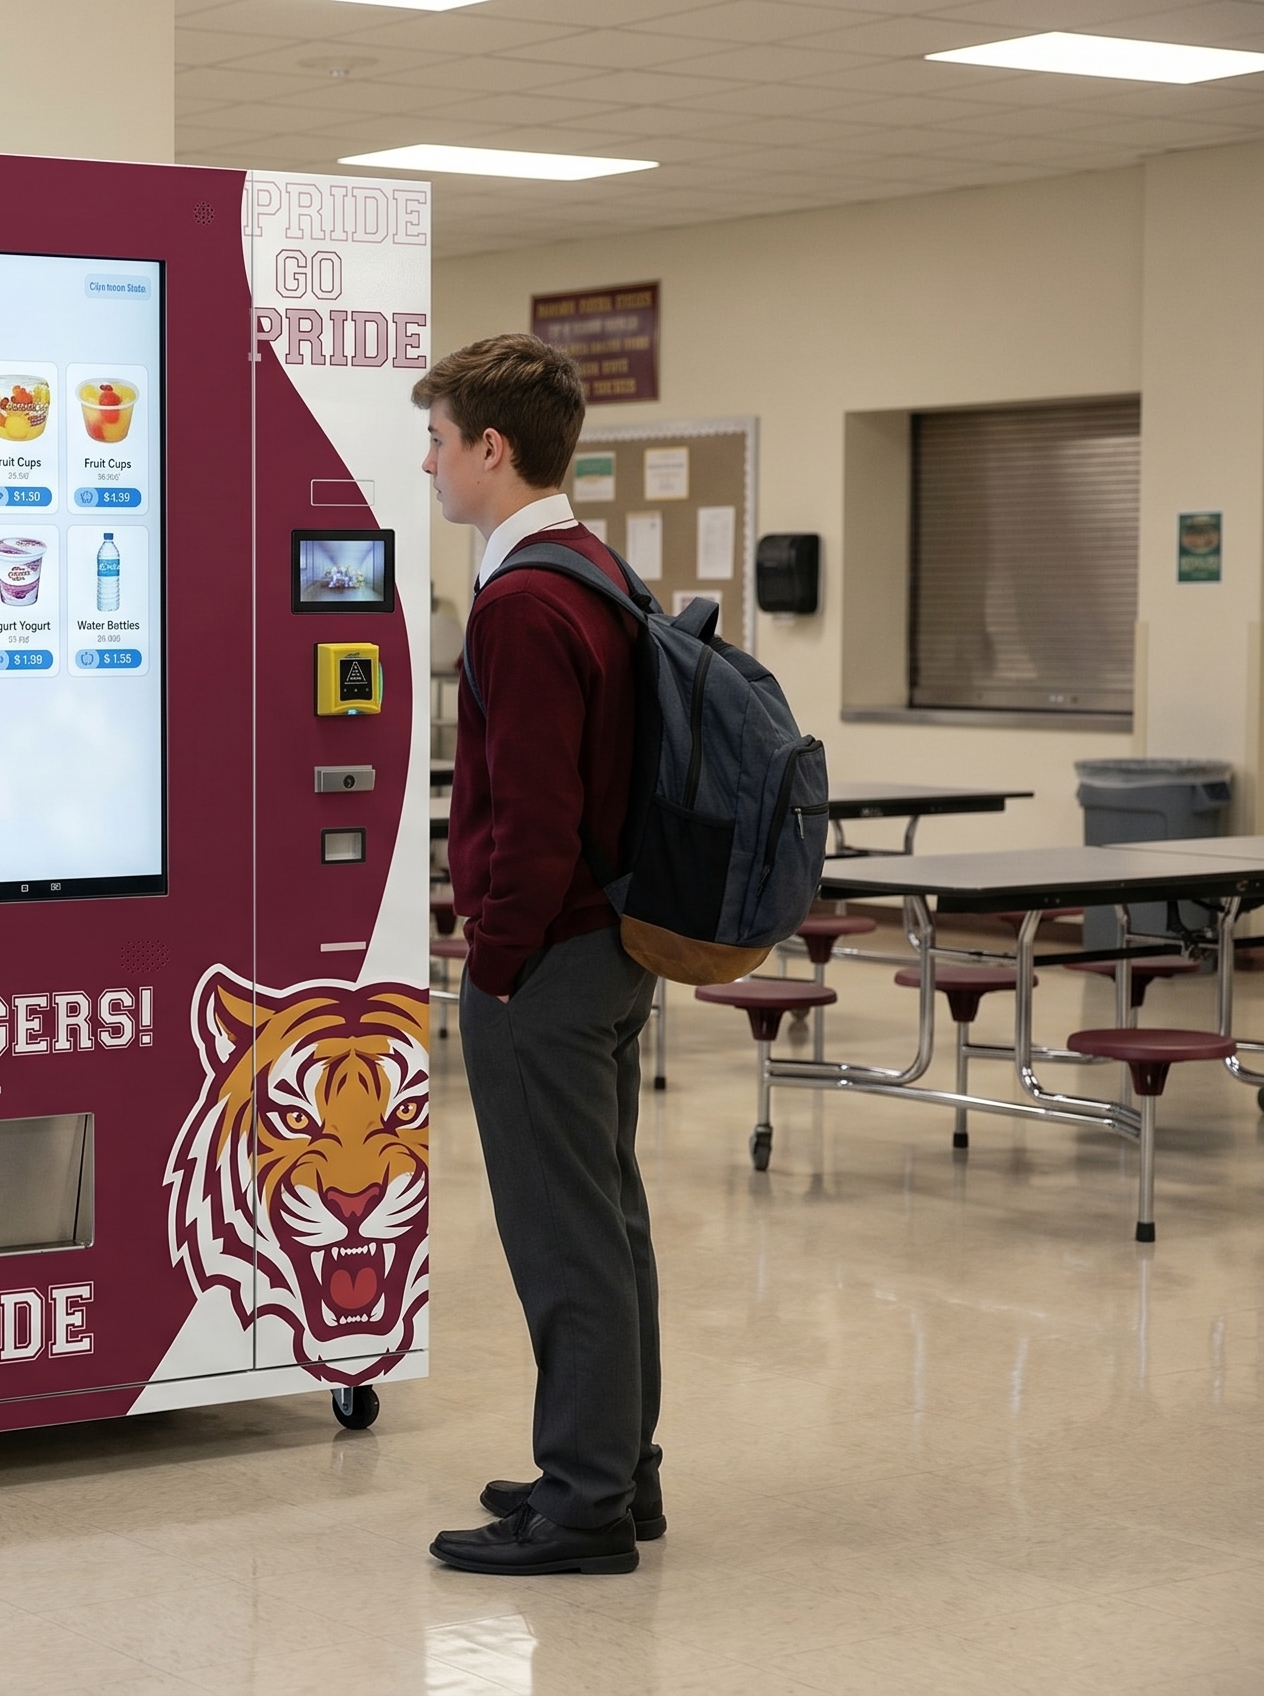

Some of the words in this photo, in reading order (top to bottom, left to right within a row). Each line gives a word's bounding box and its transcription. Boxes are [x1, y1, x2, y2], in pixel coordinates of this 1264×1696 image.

[244, 180, 427, 246] PRIDE
[275, 248, 342, 301] GO
[247, 307, 427, 369] PRIDE
[17, 457, 42, 470] Cups
[84, 458, 106, 468] Fruit
[108, 458, 132, 471] Cups
[19, 620, 51, 633] Yogurt
[76, 620, 105, 630] Water
